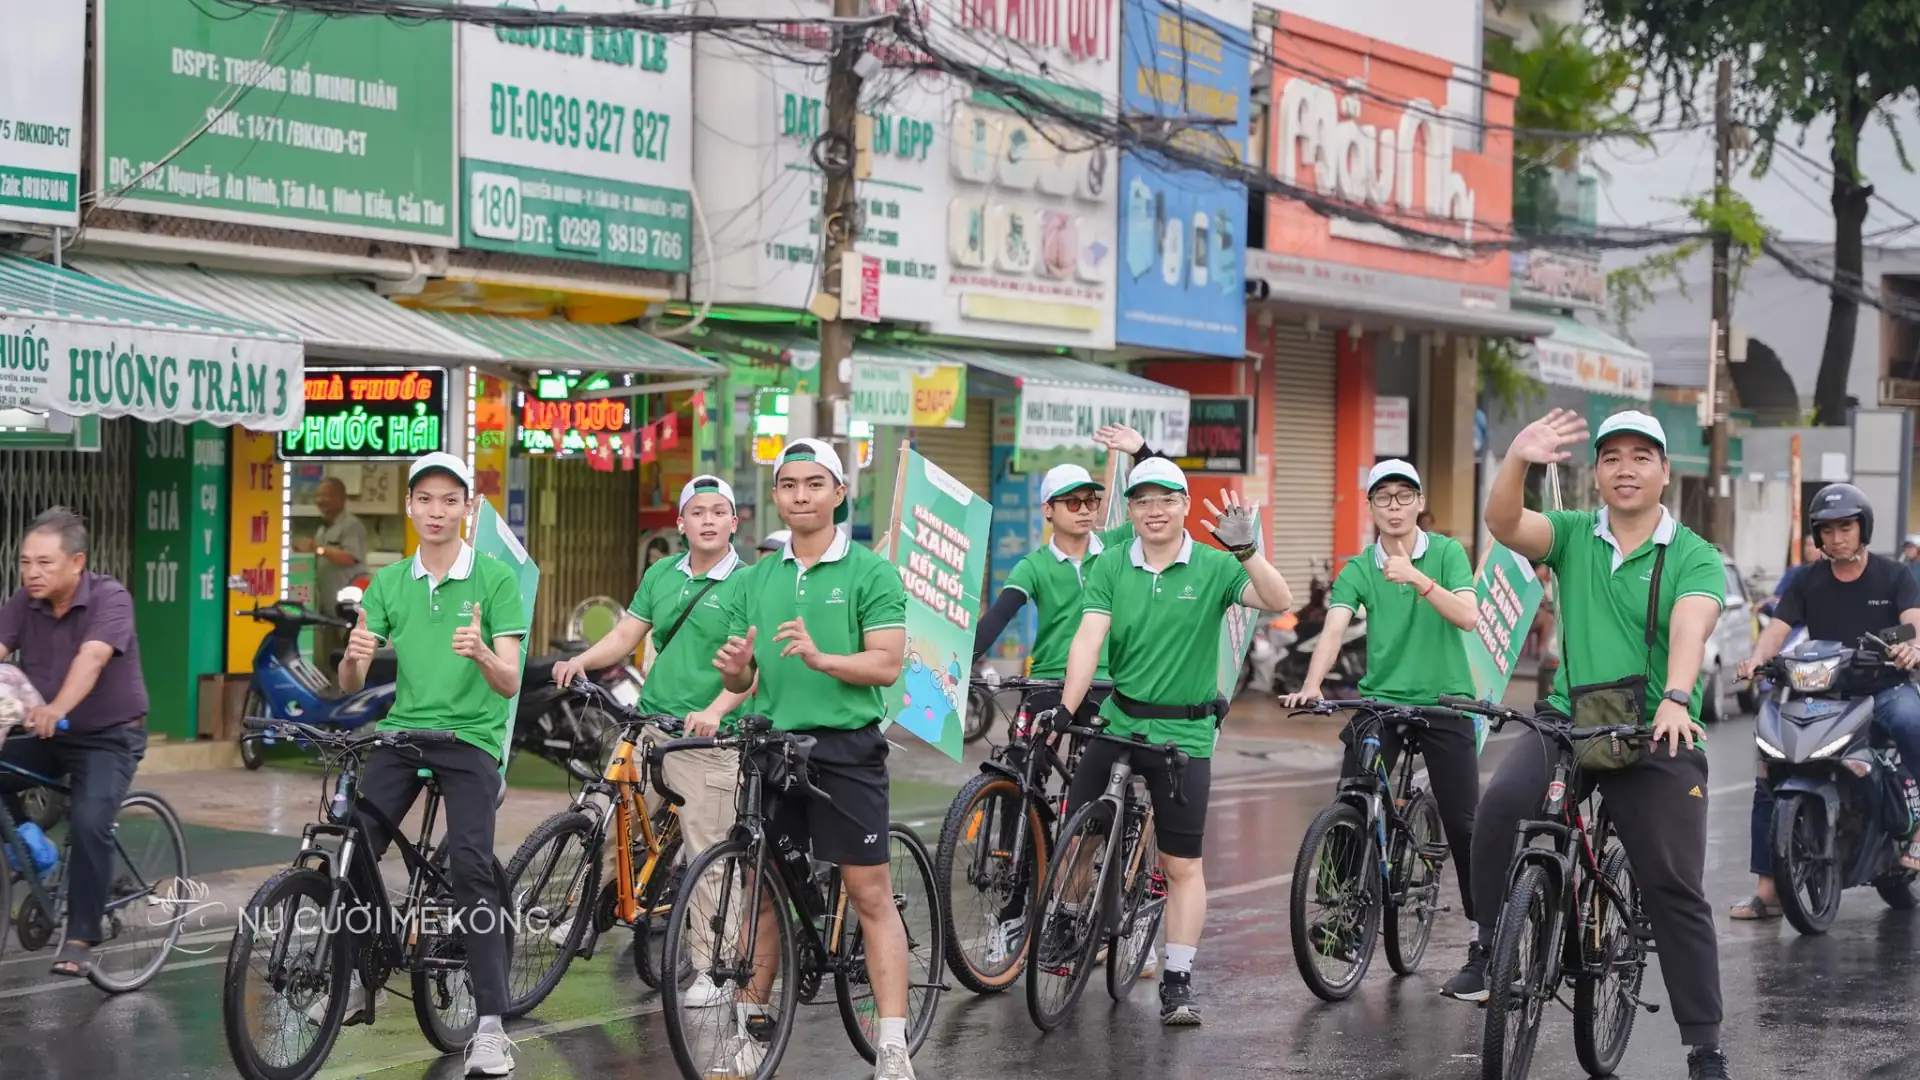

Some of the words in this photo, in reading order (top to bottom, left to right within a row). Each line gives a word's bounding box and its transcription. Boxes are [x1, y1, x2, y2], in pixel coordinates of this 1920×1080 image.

[172, 47, 220, 81] DSPT:
[314, 73, 356, 104] MINH
[586, 99, 625, 154] 327
[632, 108, 671, 162] 827
[898, 115, 935, 161] GPP
[478, 183, 518, 228] 180
[521, 213, 554, 244] ĐT:
[558, 215, 602, 249] 0292
[607, 223, 648, 256] 3819
[652, 229, 683, 261] 766
[68, 341, 180, 409] HƯƠNG
[187, 347, 267, 415] TRÀM
[272, 367, 288, 417] 3
[350, 371, 433, 401] THUỐC
[286, 404, 384, 454] PHƯỚC
[388, 401, 439, 454] HẢI
[147, 482, 180, 531] GIÁ
[914, 504, 942, 531] HÀNH
[942, 522, 972, 552] TRÌNH
[914, 521, 966, 573] XANH
[145, 545, 178, 602] TỐT
[908, 550, 937, 581] KẾT
[936, 570, 964, 601] NỐI
[945, 600, 971, 631] LAI
[1489, 577, 1518, 631] XANH
